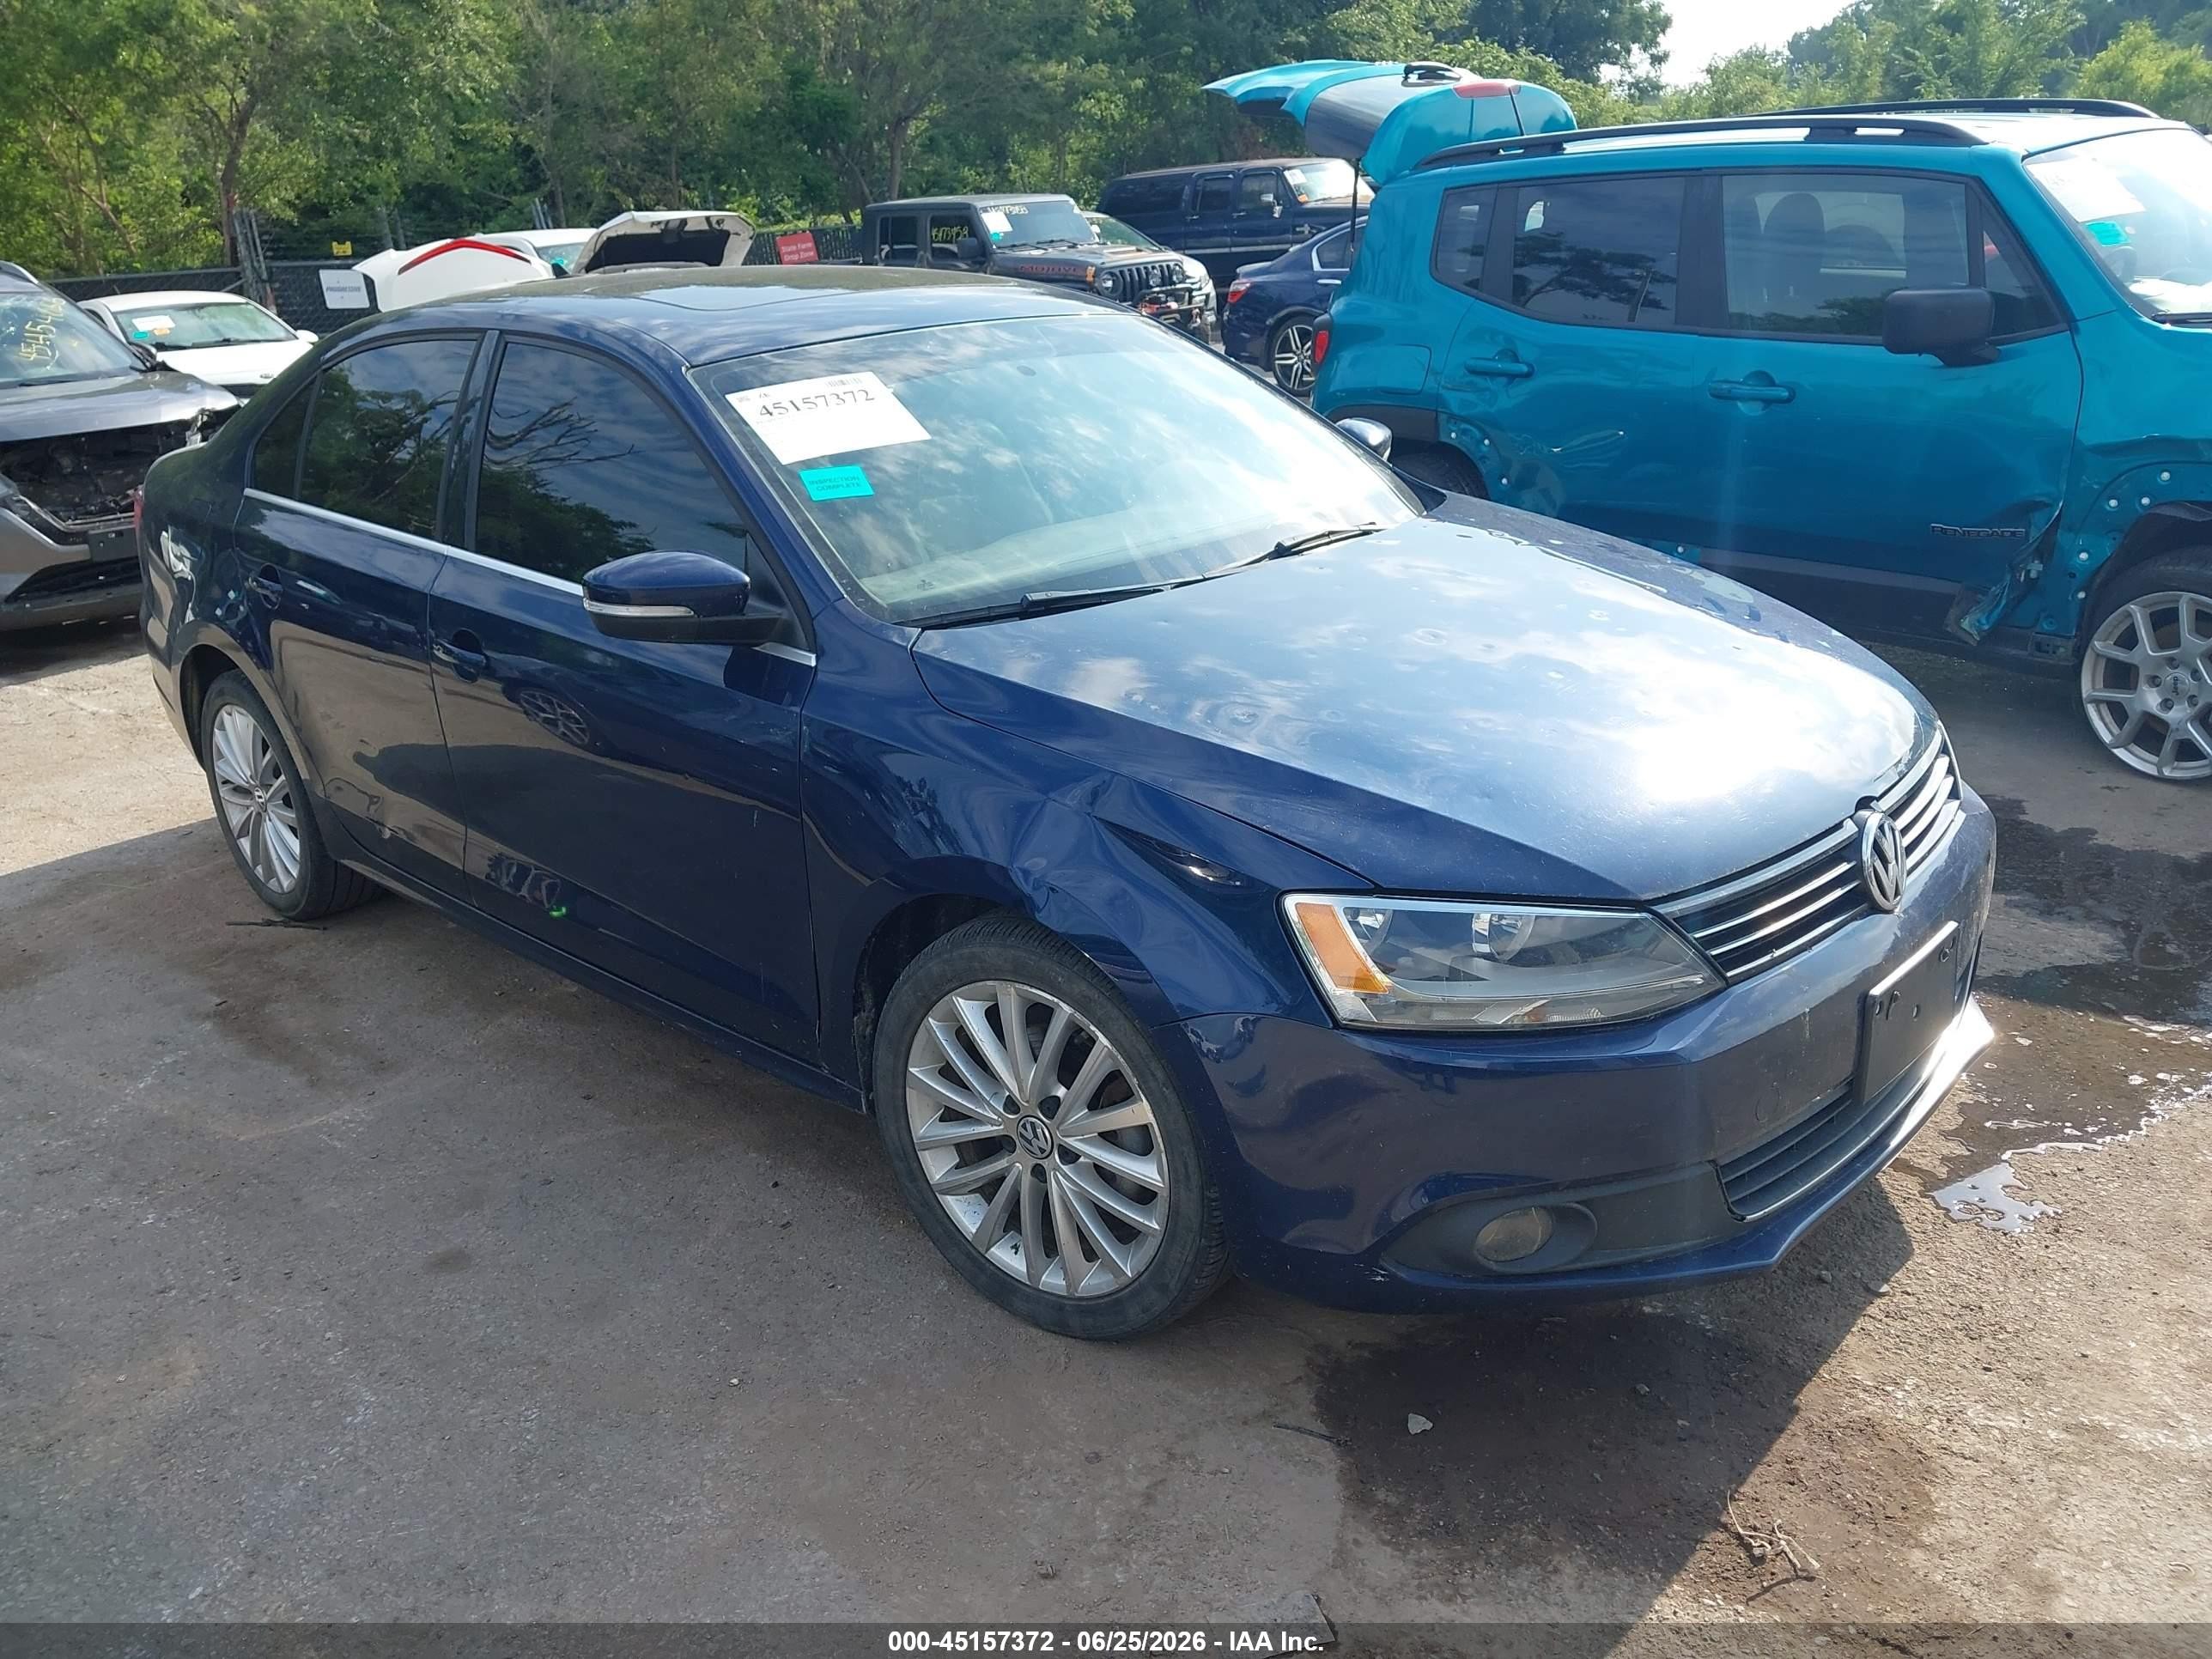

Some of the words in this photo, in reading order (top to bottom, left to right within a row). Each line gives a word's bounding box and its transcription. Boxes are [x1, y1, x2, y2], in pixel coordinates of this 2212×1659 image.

[759, 389, 875, 416] 45157372
[809, 475, 860, 485] INSPECTION
[817, 482, 861, 491] COMPLETE
[1930, 524, 2026, 538] RENEGADE
